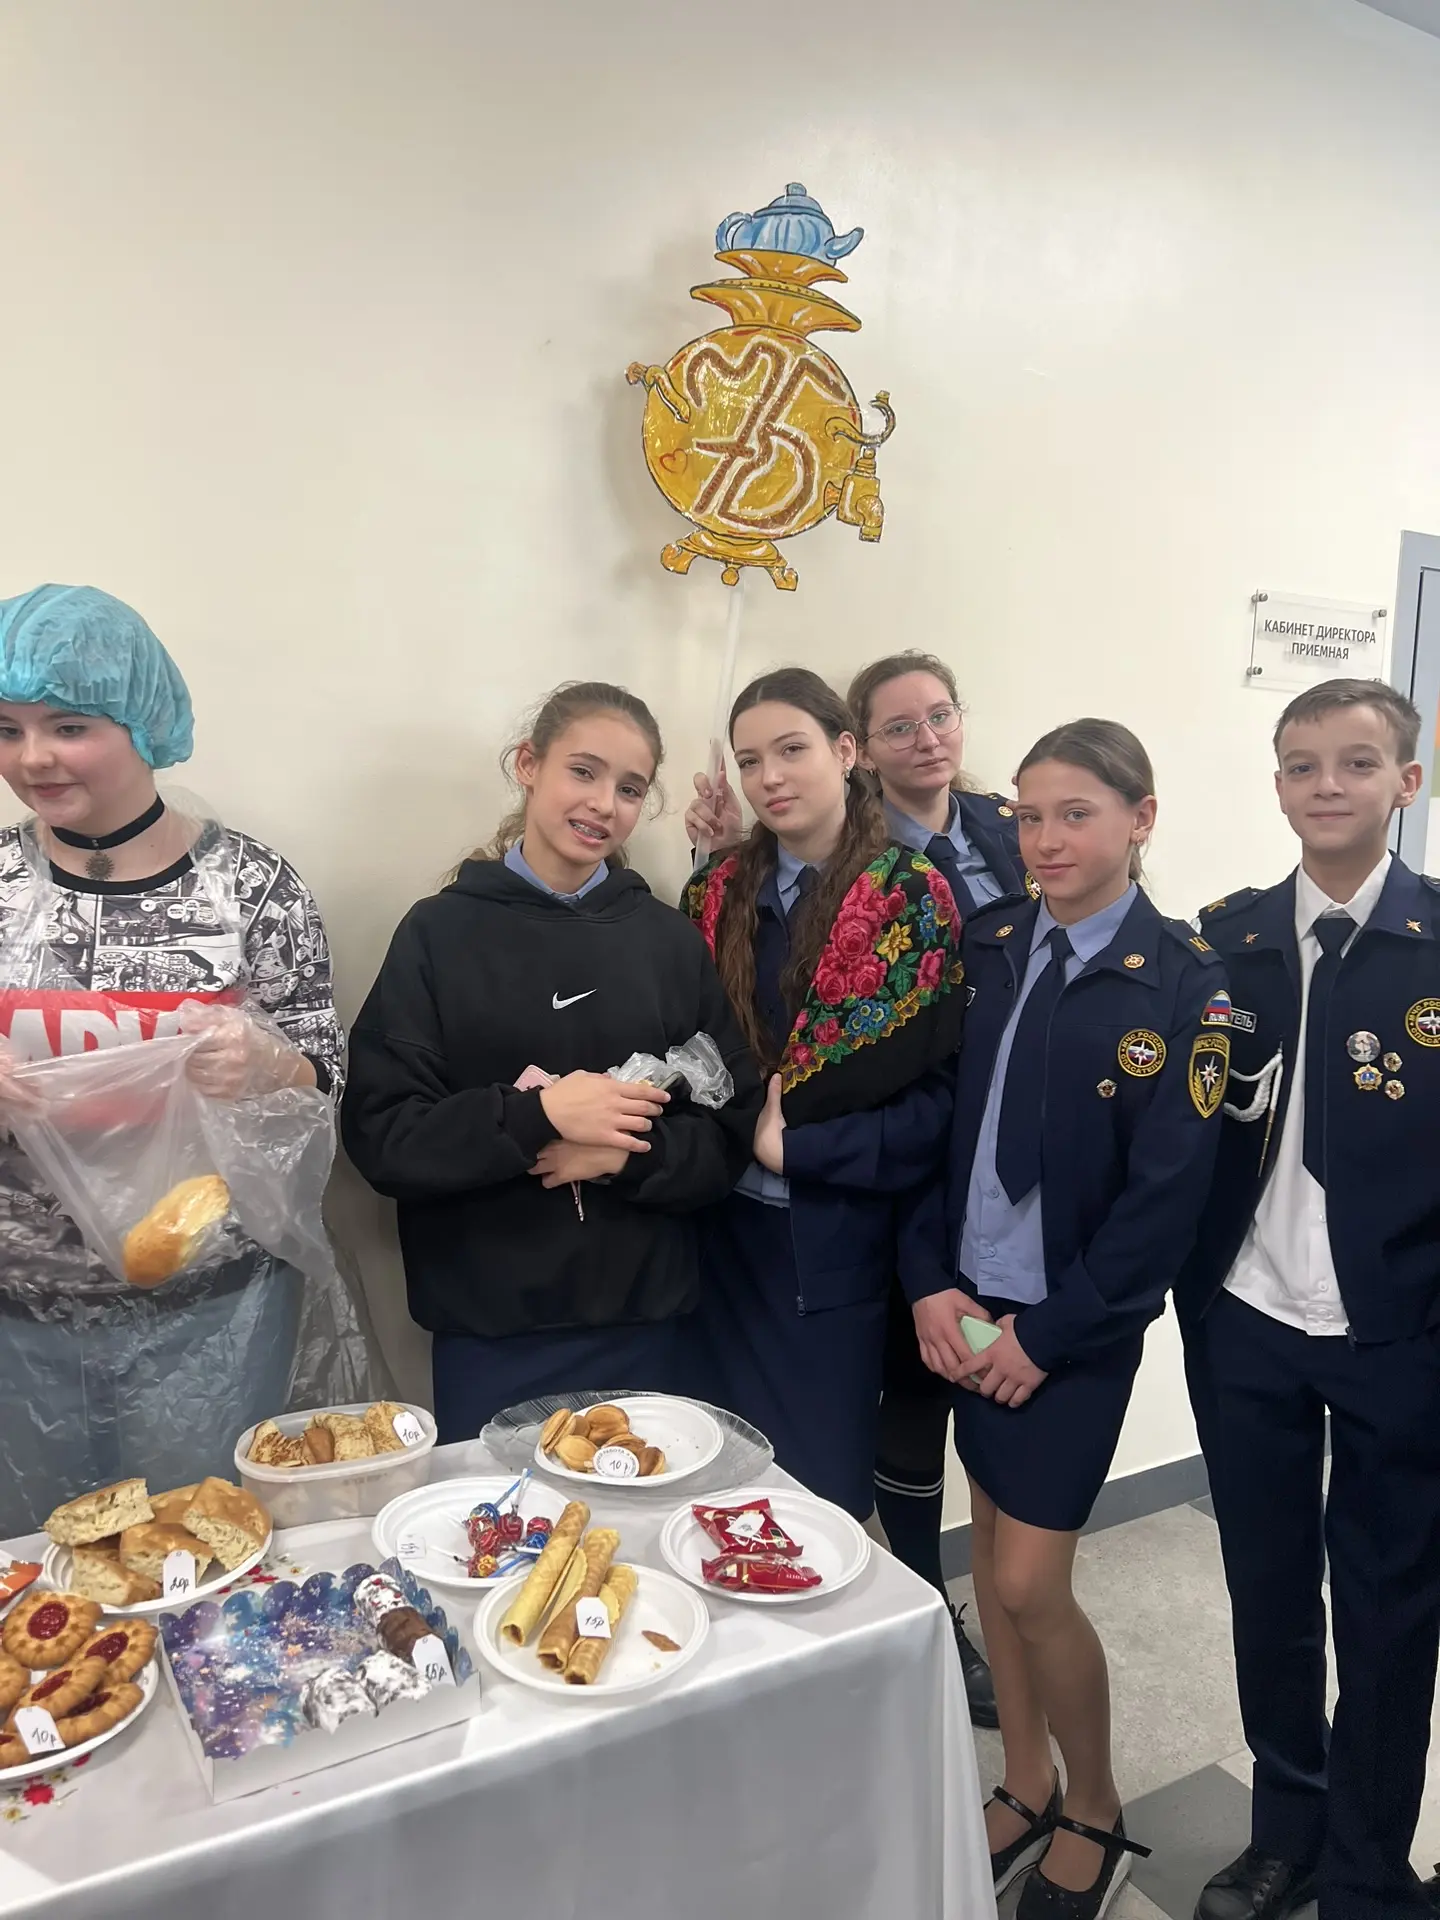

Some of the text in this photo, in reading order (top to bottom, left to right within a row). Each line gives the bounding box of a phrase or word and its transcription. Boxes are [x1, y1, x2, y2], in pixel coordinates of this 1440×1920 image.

[1264, 618, 1376, 644] КАБИНЕТ ДИРЕКТОРА
[1291, 642, 1349, 660] ПРИЕМНАЯ
[1409, 1005, 1422, 1021] МЧС
[1121, 1031, 1164, 1054] МЧС РОССИИ
[1411, 1027, 1440, 1044] СПАСА
